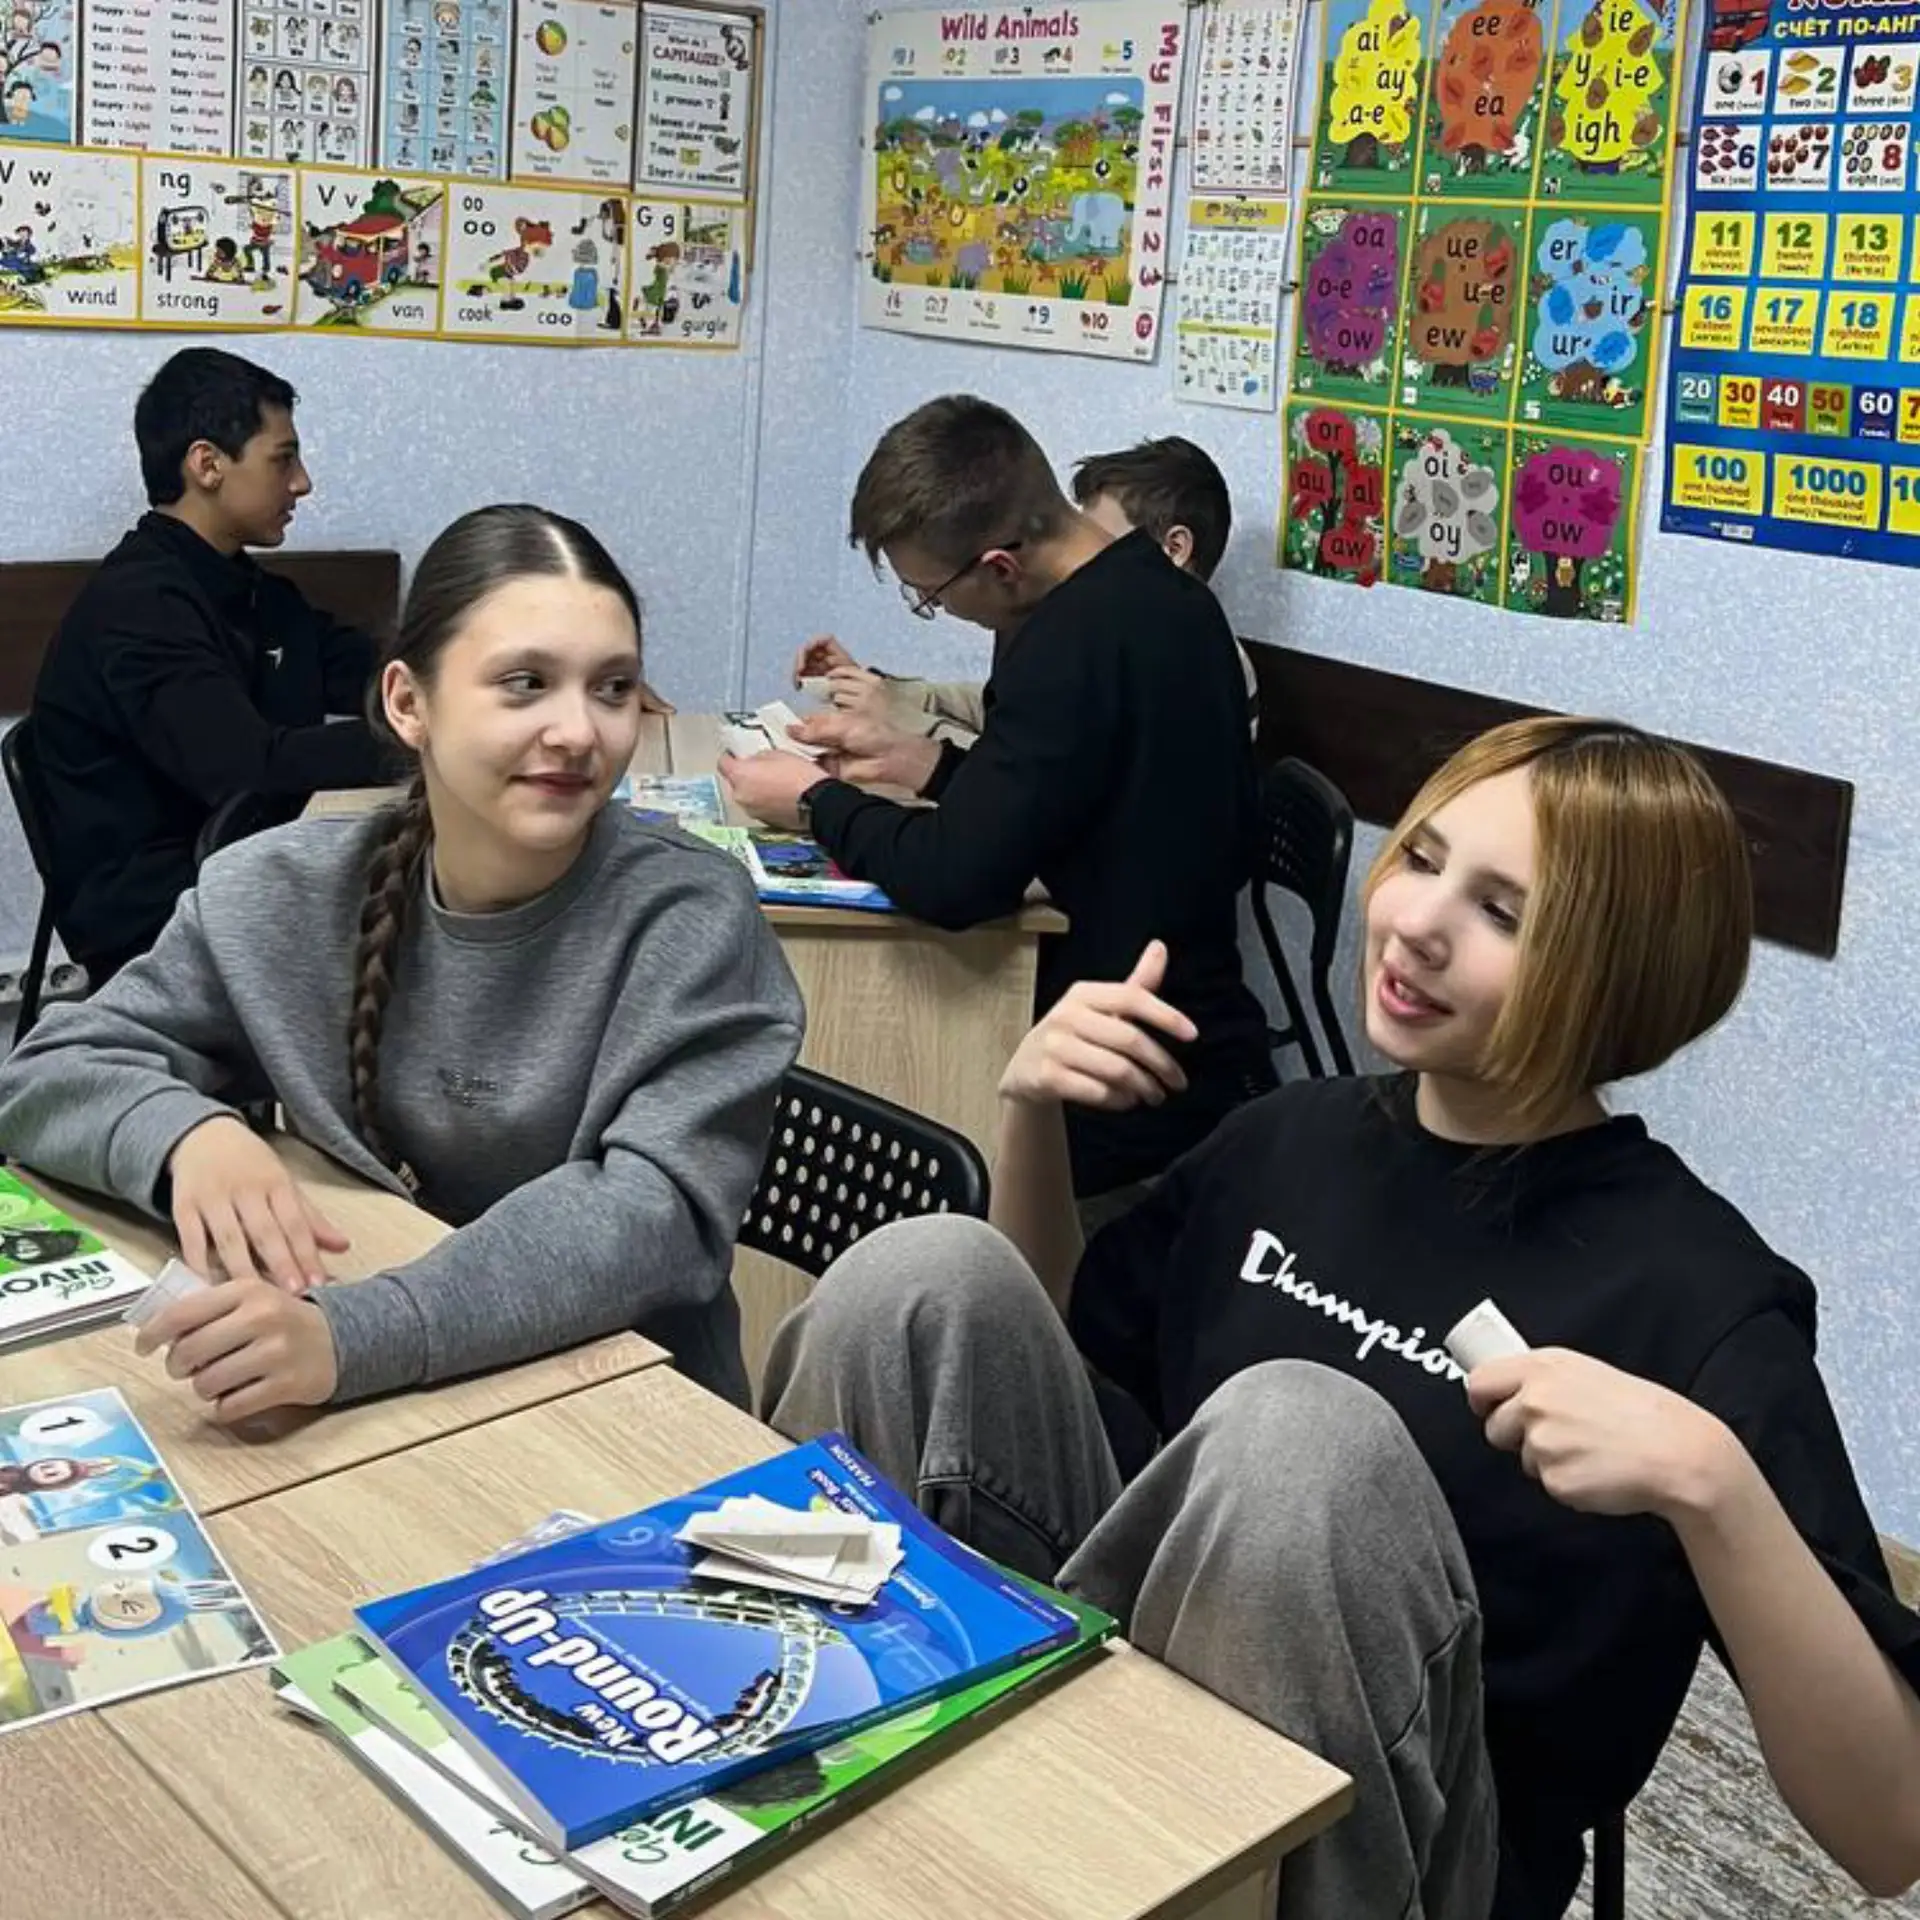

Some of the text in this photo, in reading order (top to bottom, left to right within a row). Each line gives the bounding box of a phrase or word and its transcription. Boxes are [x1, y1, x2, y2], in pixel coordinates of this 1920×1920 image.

[941, 10, 1079, 41] Wild Animals
[1472, 16, 1500, 36] ee
[1609, 5, 1633, 33] ie
[1774, 19, 1832, 39] СЧЁТ
[1121, 40, 1134, 60] 5
[1357, 26, 1381, 53] ai
[1009, 47, 1020, 65] 3
[1150, 24, 1180, 84] My
[1575, 55, 1650, 87] y i-e
[1750, 69, 1766, 95] 1
[1816, 67, 1837, 93] 2
[1891, 65, 1914, 92] 3
[1376, 70, 1406, 100] ay
[1349, 104, 1385, 125] a-e
[1475, 95, 1505, 116] ea
[1147, 103, 1171, 190] First
[1575, 117, 1621, 156] igh
[1738, 144, 1755, 169] 6
[1811, 145, 1830, 170] 7
[1882, 144, 1903, 170] 8
[29, 170, 52, 187] w
[159, 171, 191, 197] ng
[317, 184, 359, 209] V v
[463, 220, 497, 237] oo
[637, 205, 676, 236] G g
[1141, 232, 1161, 252] 2
[1353, 227, 1385, 247] oa
[1711, 221, 1742, 247] 11
[1777, 222, 1812, 248] 12
[1850, 224, 1888, 250] 13
[1447, 237, 1479, 258] ue
[1550, 240, 1577, 260] er
[1139, 266, 1161, 288] 3
[1317, 278, 1353, 298] o-e
[67, 287, 118, 306] wind
[156, 292, 219, 316] strong
[1464, 282, 1505, 304] u-e
[1610, 290, 1634, 316] ir
[392, 302, 425, 320] van
[458, 303, 494, 322] cook
[1037, 305, 1051, 324] 9
[1699, 295, 1732, 320] 16
[1766, 297, 1804, 324] 17
[1841, 302, 1879, 329] 18
[681, 316, 728, 340] gurgle
[1089, 312, 1109, 330] 10
[1337, 328, 1373, 348] ow
[1426, 327, 1467, 347] ew
[1552, 335, 1580, 356] ur
[1681, 378, 1711, 399] 20
[1726, 382, 1755, 404] 30
[1767, 385, 1800, 407] 40
[1812, 388, 1846, 412] 50
[1859, 392, 1893, 416] 60
[1319, 422, 1343, 441] or
[1424, 453, 1449, 478] oi
[1550, 463, 1584, 486] ou
[1693, 455, 1748, 483] 100
[1297, 471, 1326, 494] au
[1353, 476, 1373, 503] al
[1789, 463, 1868, 497] 1000
[1430, 522, 1461, 556] oy
[1542, 519, 1584, 544] ow
[1331, 536, 1365, 559] aw
[40, 1416, 85, 1433] 1
[107, 1536, 158, 1561] 2
[477, 1586, 723, 1766] Round-Up
[574, 1702, 637, 1750] New
